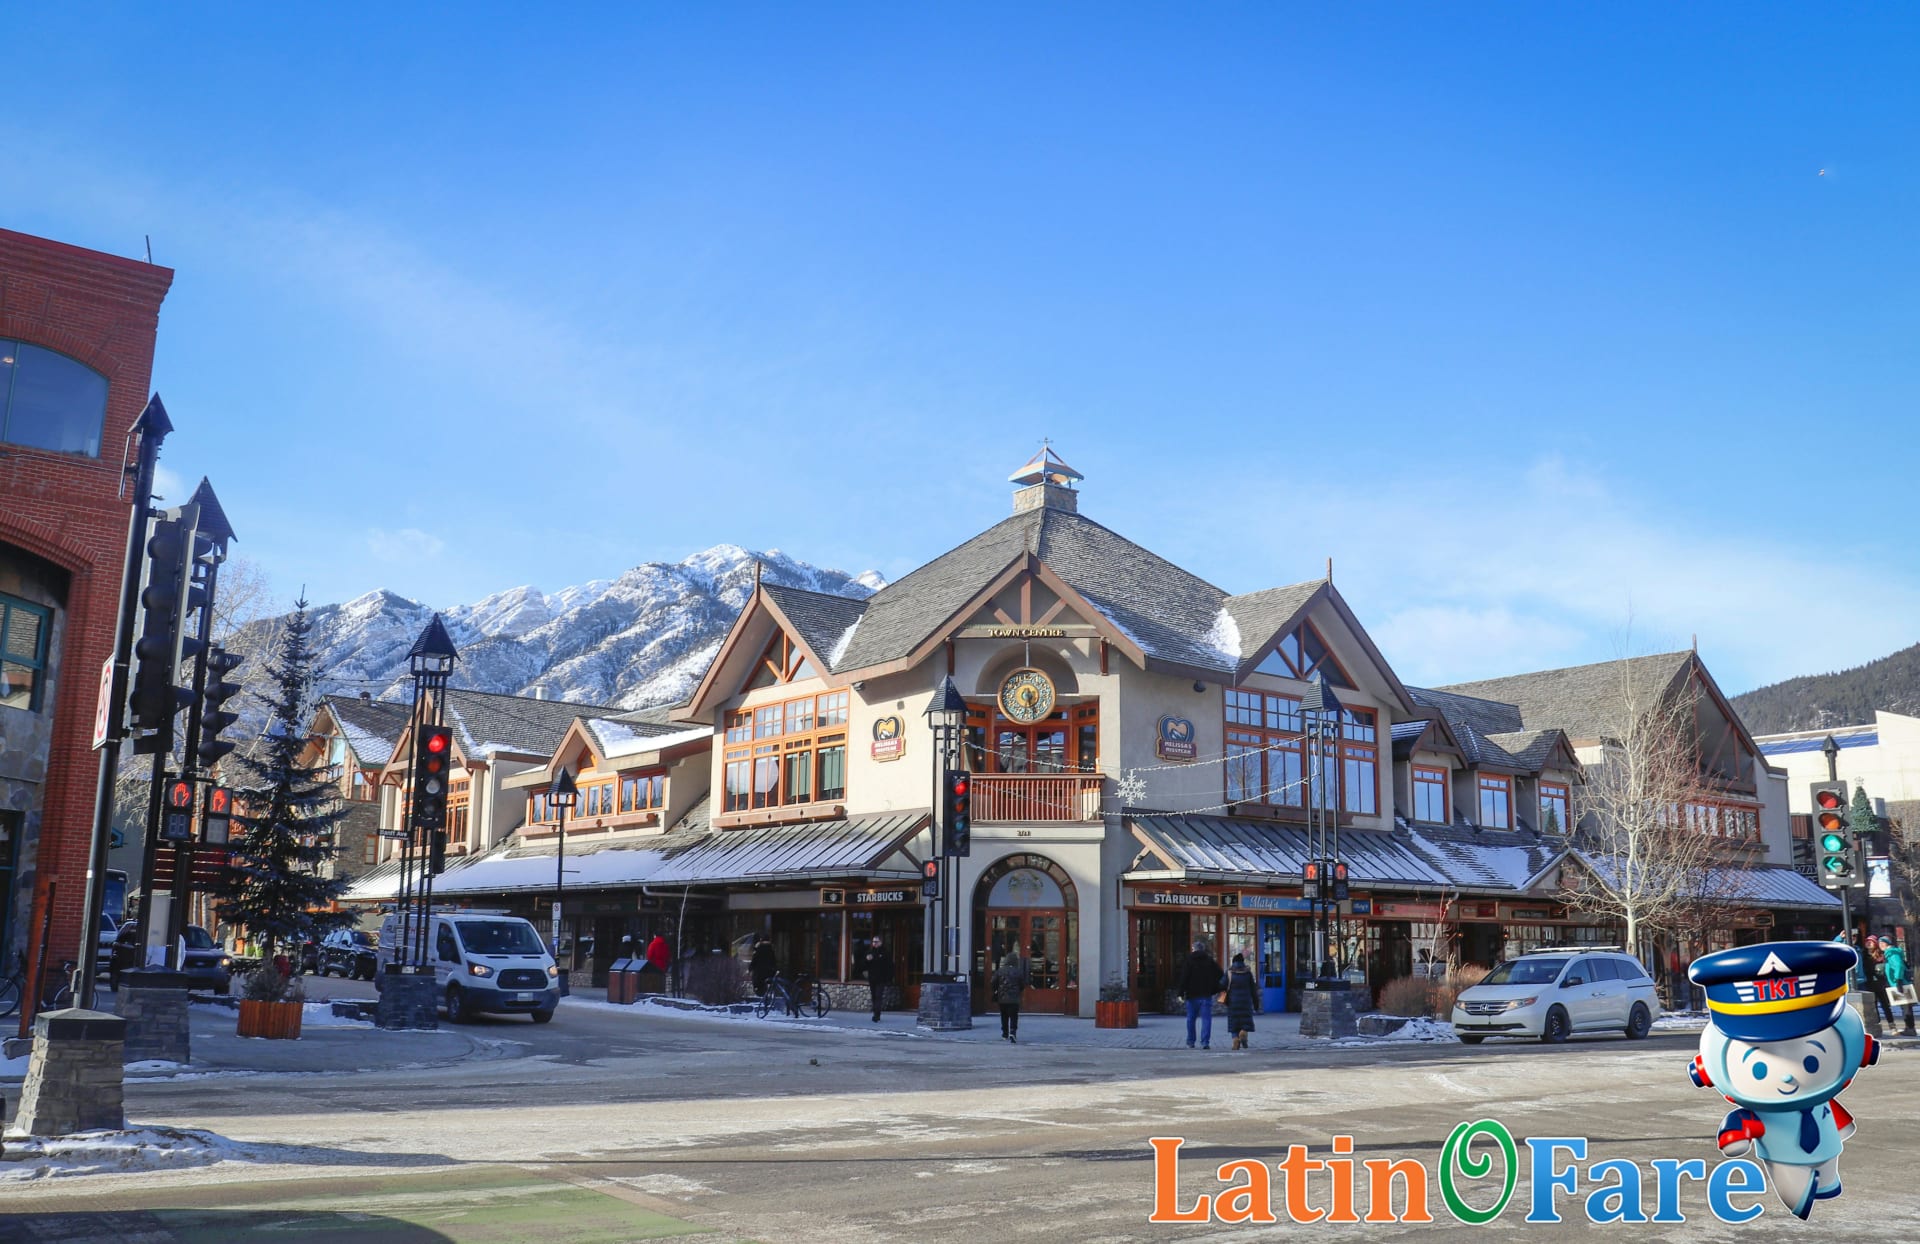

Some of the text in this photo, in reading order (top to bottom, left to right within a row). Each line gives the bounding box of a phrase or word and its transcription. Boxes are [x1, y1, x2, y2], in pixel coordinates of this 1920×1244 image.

[987, 629, 1064, 637] TOWN CENTRE
[857, 891, 904, 903] STARBUCKS
[1154, 893, 1210, 905] STARBUCKS
